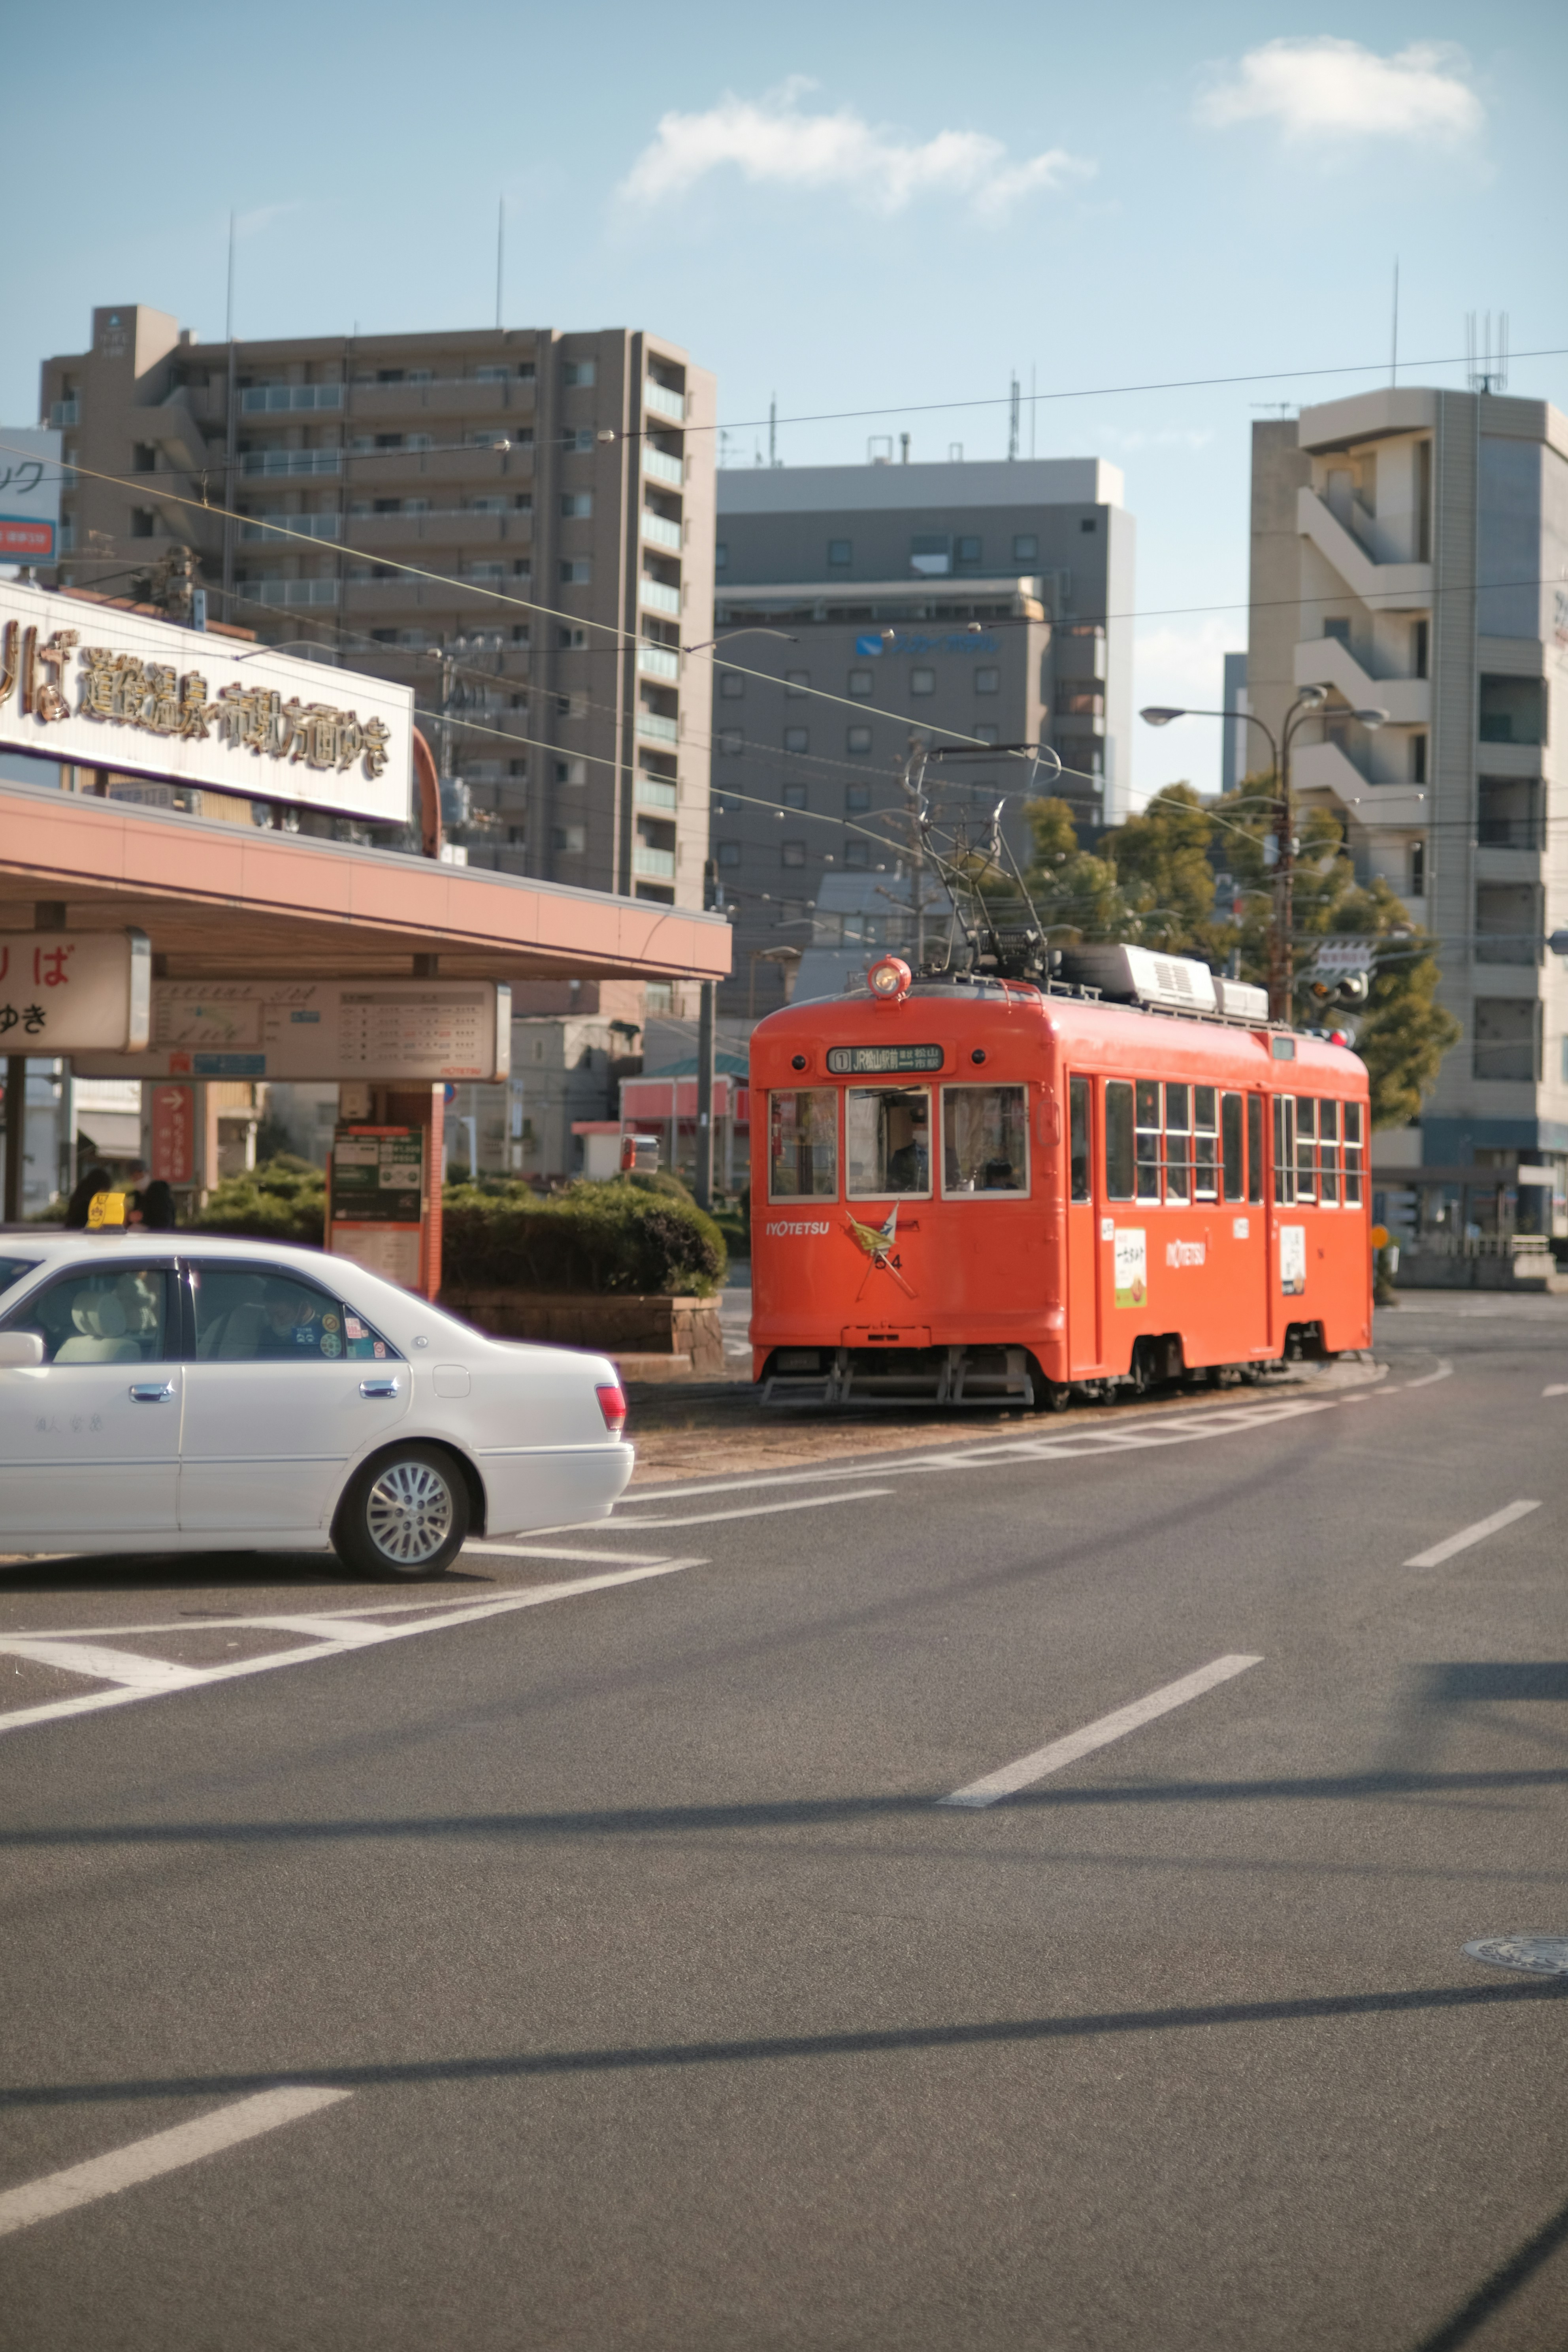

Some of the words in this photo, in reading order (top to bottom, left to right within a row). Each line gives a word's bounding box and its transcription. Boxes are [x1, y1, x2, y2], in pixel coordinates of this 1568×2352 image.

[853, 1049, 898, 1070] JR松山駅前
[766, 1221, 829, 1236] IYOTETSU
